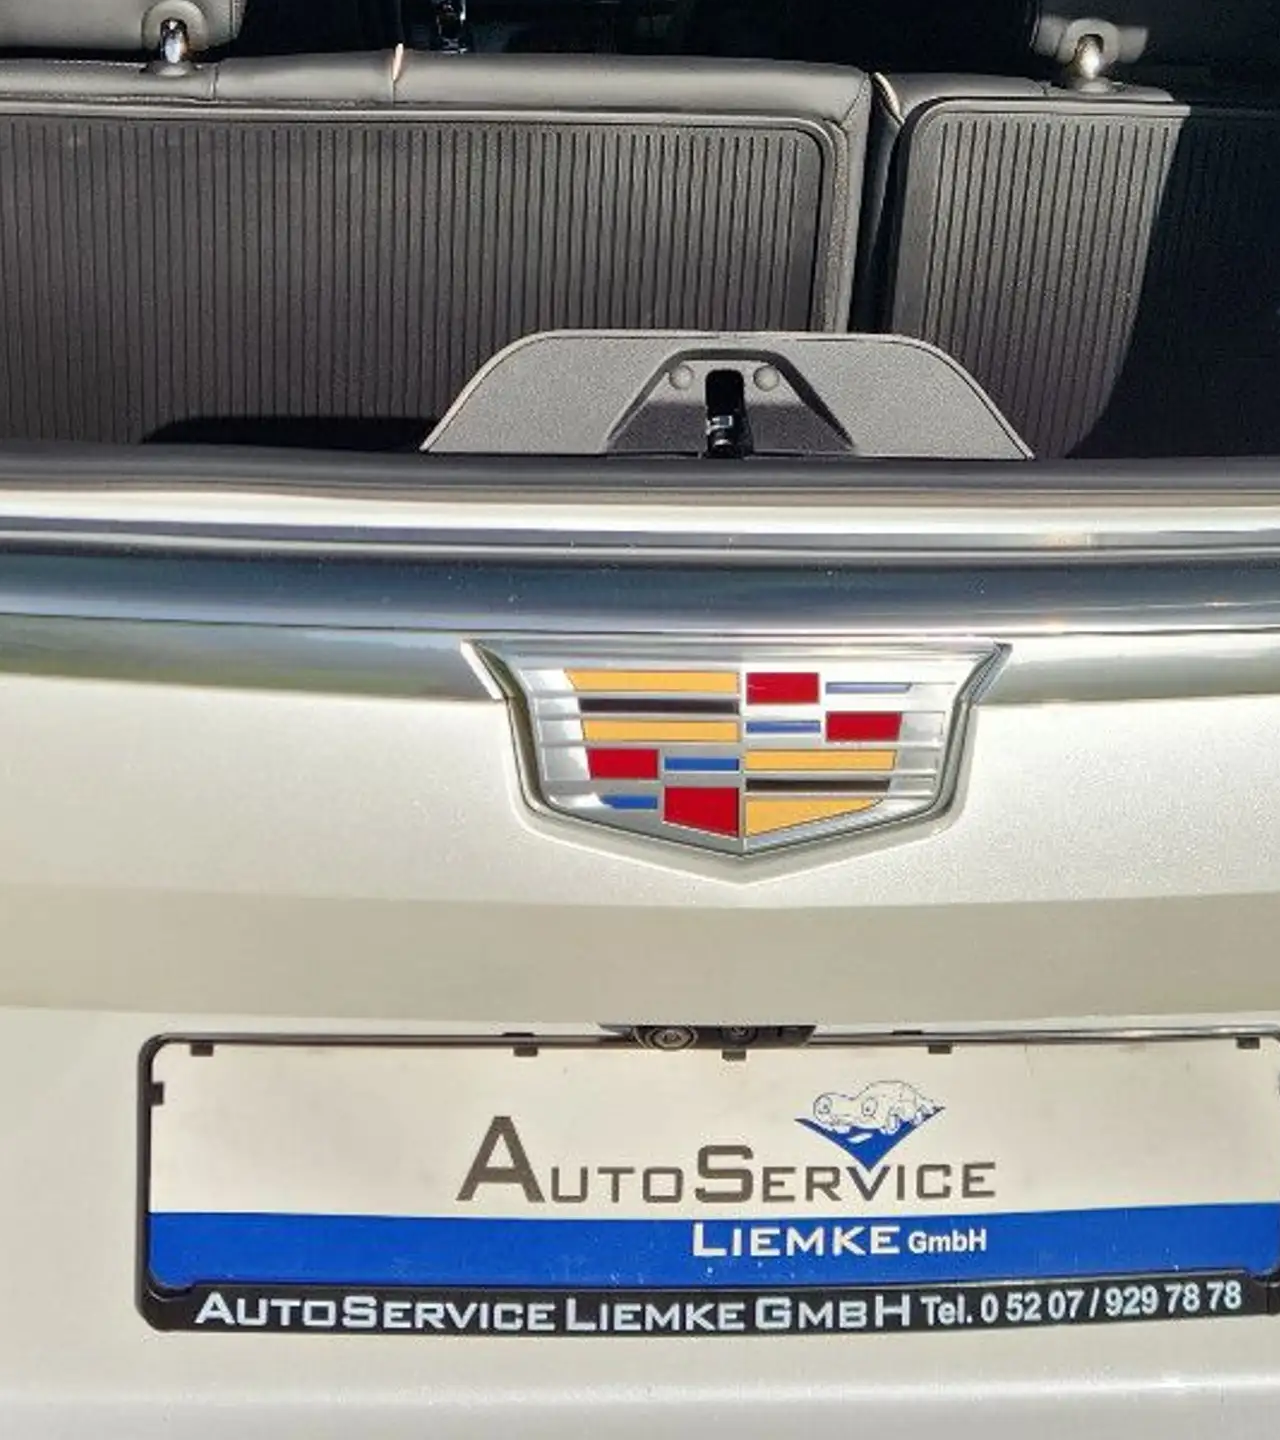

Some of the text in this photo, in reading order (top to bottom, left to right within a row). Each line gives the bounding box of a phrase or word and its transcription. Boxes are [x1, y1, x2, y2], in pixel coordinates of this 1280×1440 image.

[692, 1221, 987, 1257] LIEMKE GmbH
[195, 1291, 556, 1332] AUTOSERVICE
[565, 1297, 745, 1332] LIEMKE
[754, 1294, 911, 1329] GMBH
[920, 1294, 972, 1326] Tel.
[1006, 1291, 1042, 1323] 52
[1166, 1282, 1201, 1313] 78
[1207, 1280, 1242, 1311] 78
